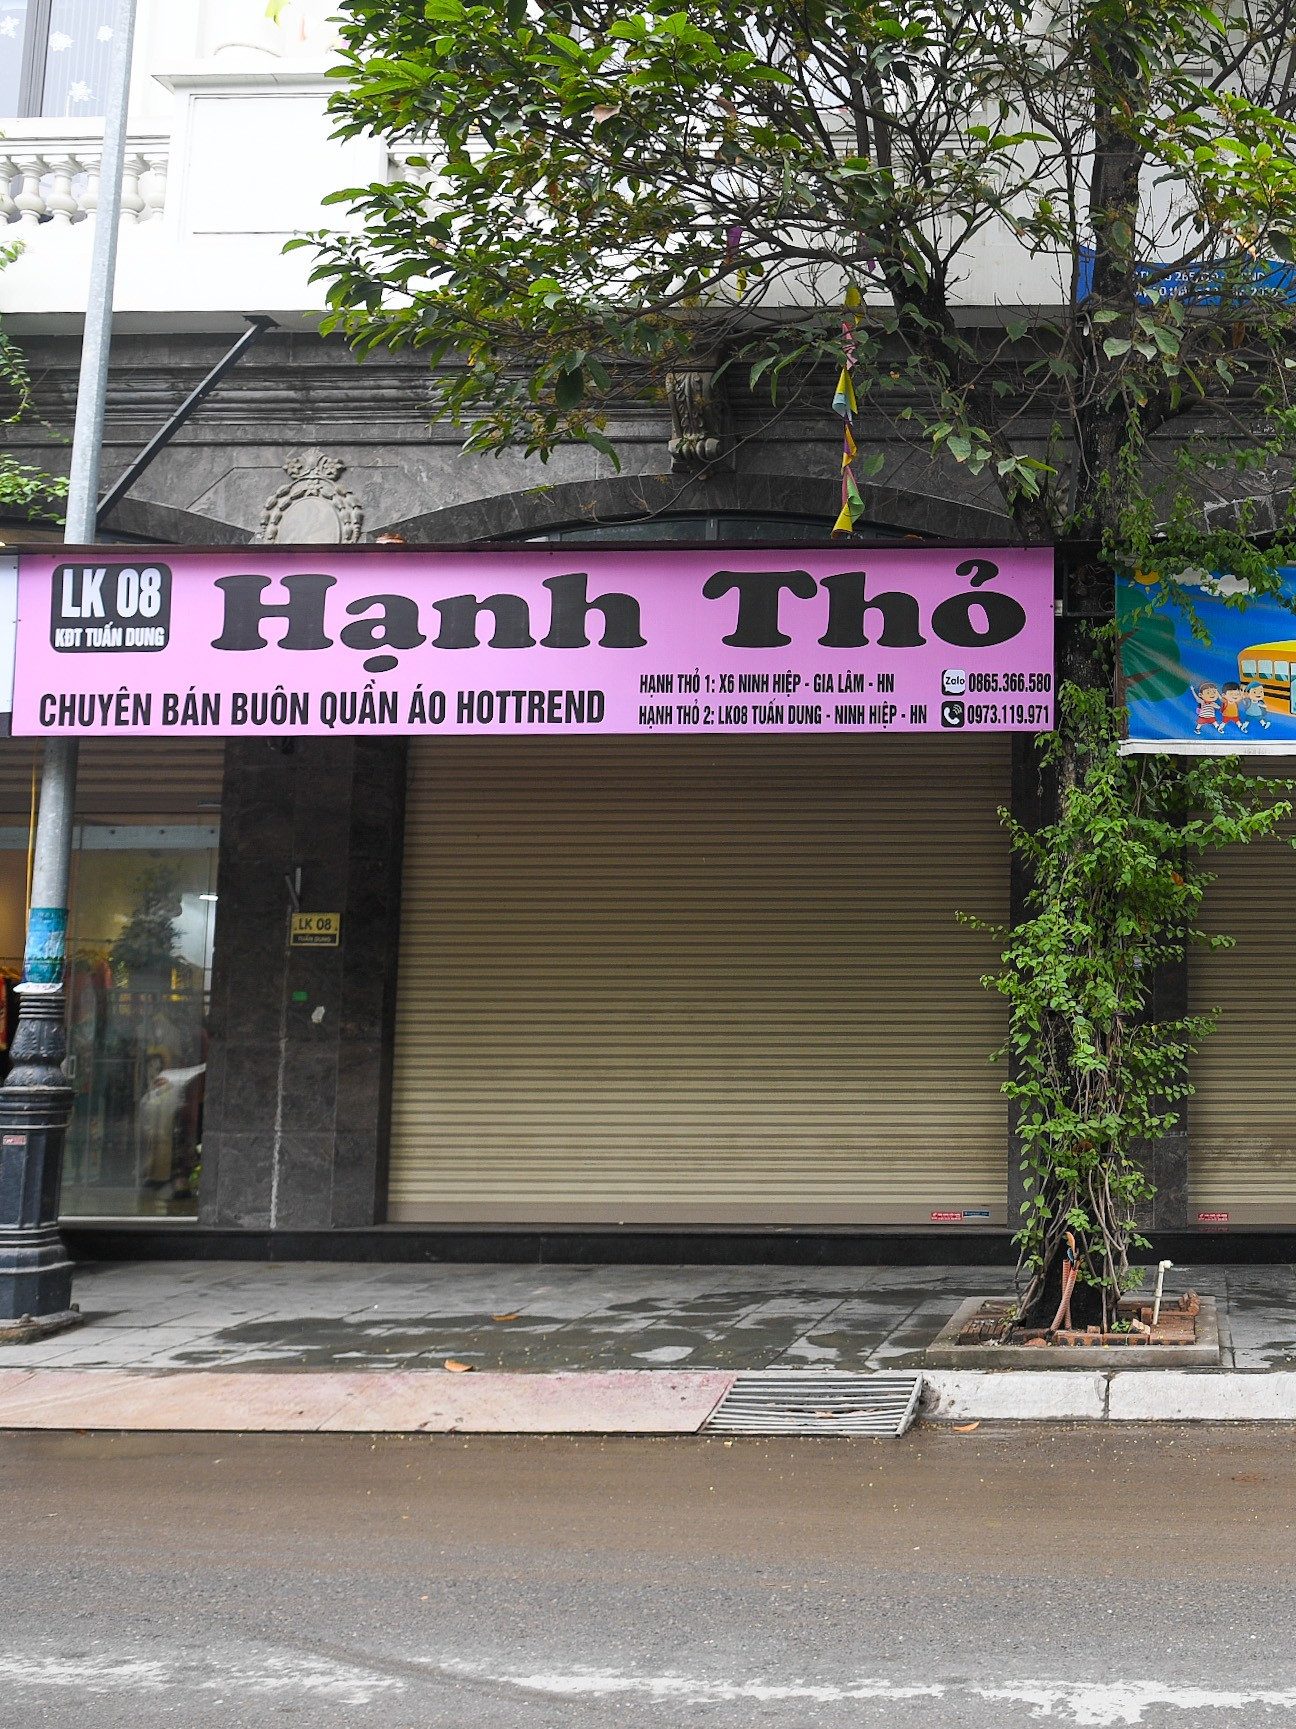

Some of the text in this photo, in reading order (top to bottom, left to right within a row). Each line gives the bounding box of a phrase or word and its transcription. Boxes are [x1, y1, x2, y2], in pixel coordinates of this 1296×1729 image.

[61, 566, 162, 618] LK 08
[210, 558, 1027, 674] Hạnh Thỏ
[55, 620, 166, 648] KĐT TUẤN DUNG
[639, 673, 674, 698] HẠNH
[677, 667, 701, 694] THỎ
[704, 674, 716, 693] 1:
[718, 673, 735, 694] X6
[738, 673, 769, 693] NINH
[772, 669, 801, 698] HIỆP
[813, 673, 835, 693] GIA
[837, 669, 865, 693] LÂM
[876, 673, 895, 693] HN
[945, 672, 1052, 693] Zalo 0865.366.580
[39, 677, 606, 730] CHUYÊN BÁN BUÔN QUẦN ÁO HOTTREND
[638, 704, 673, 729] HẠNH
[676, 698, 700, 725] THỎ
[718, 704, 748, 725] LK08
[751, 697, 784, 725] TUẤN
[787, 704, 822, 725] DUNG
[834, 704, 865, 725] NINH
[869, 700, 898, 729] HIỆP
[909, 704, 928, 725] HN
[967, 704, 1050, 725] 0973.119.971
[299, 918, 331, 930] LK 08
